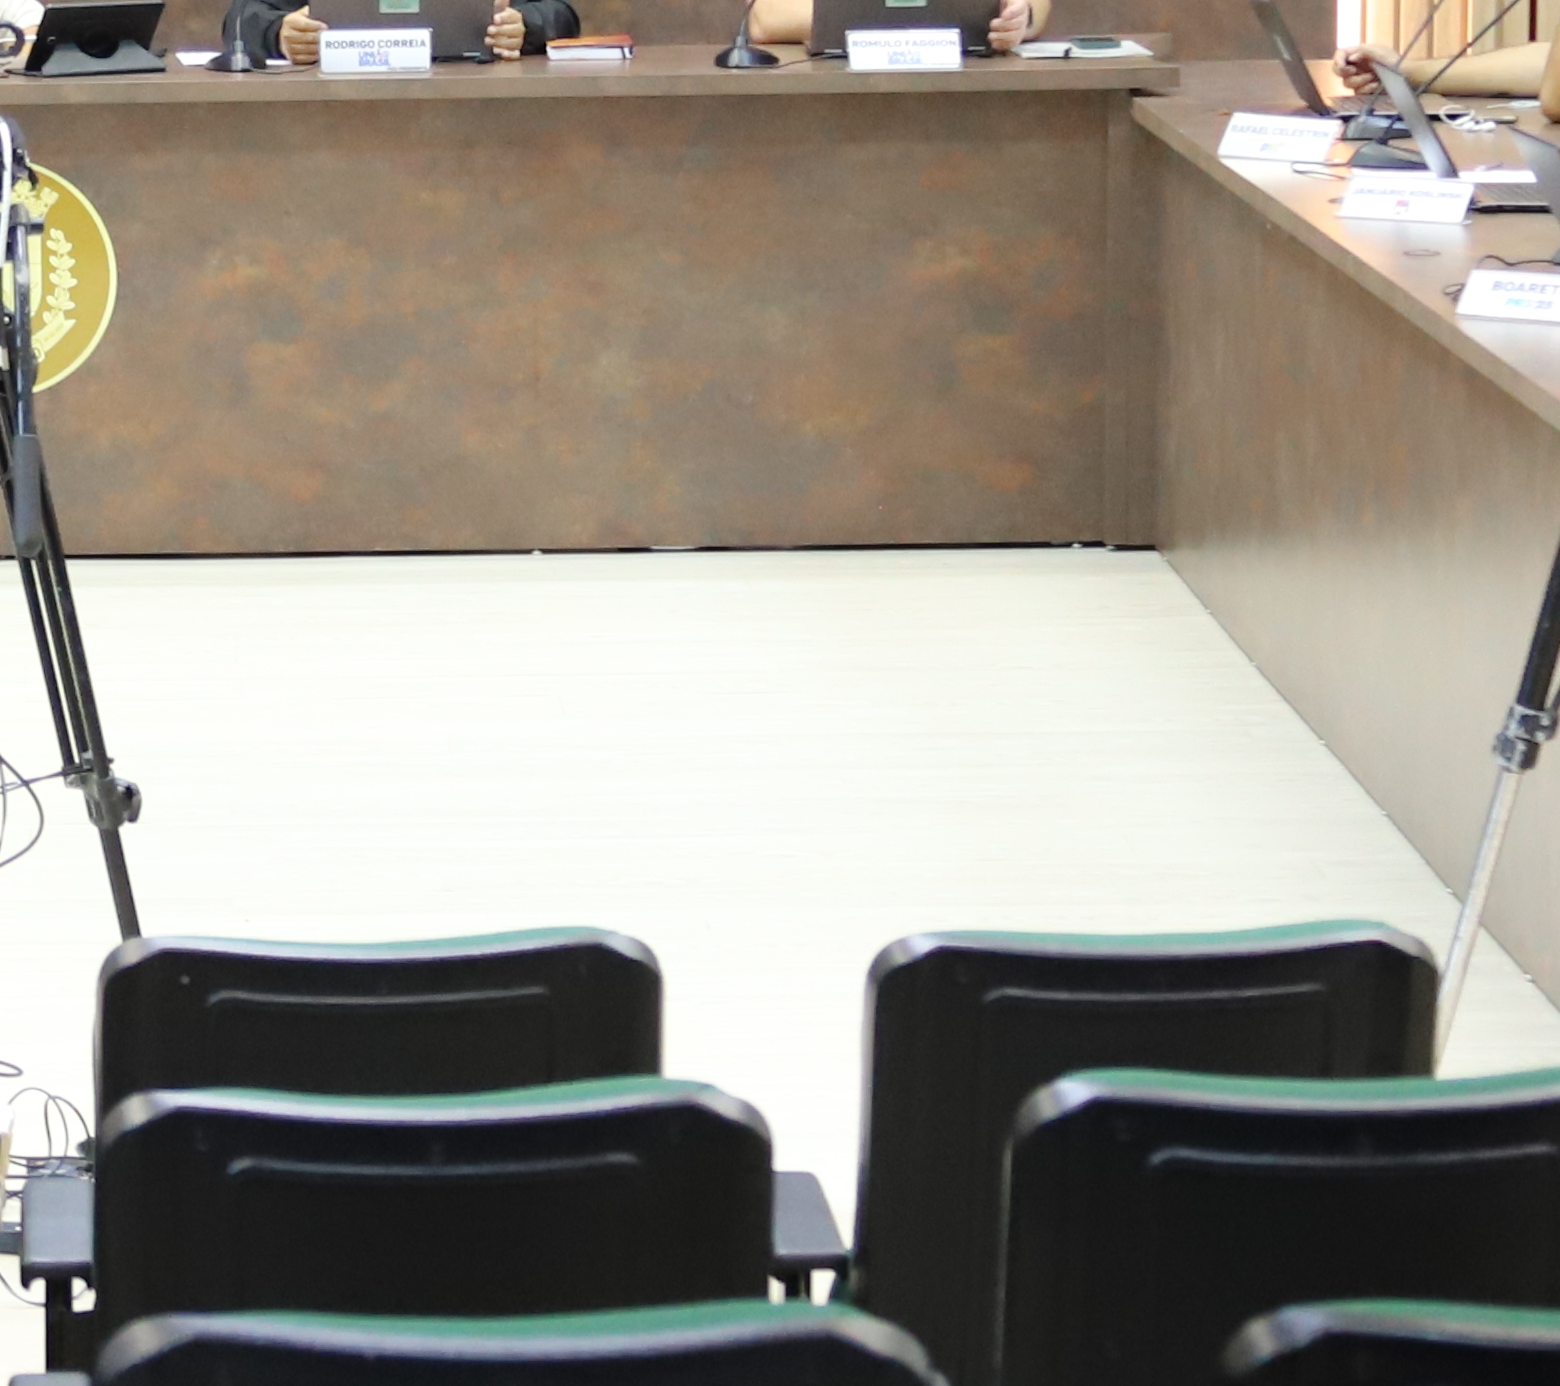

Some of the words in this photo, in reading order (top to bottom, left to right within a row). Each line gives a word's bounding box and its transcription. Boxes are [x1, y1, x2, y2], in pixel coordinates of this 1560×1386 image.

[325, 40, 375, 50] RODRIGO
[377, 39, 427, 49] CORREIA
[851, 40, 902, 48] ROMULO
[905, 39, 957, 48] FAGGION
